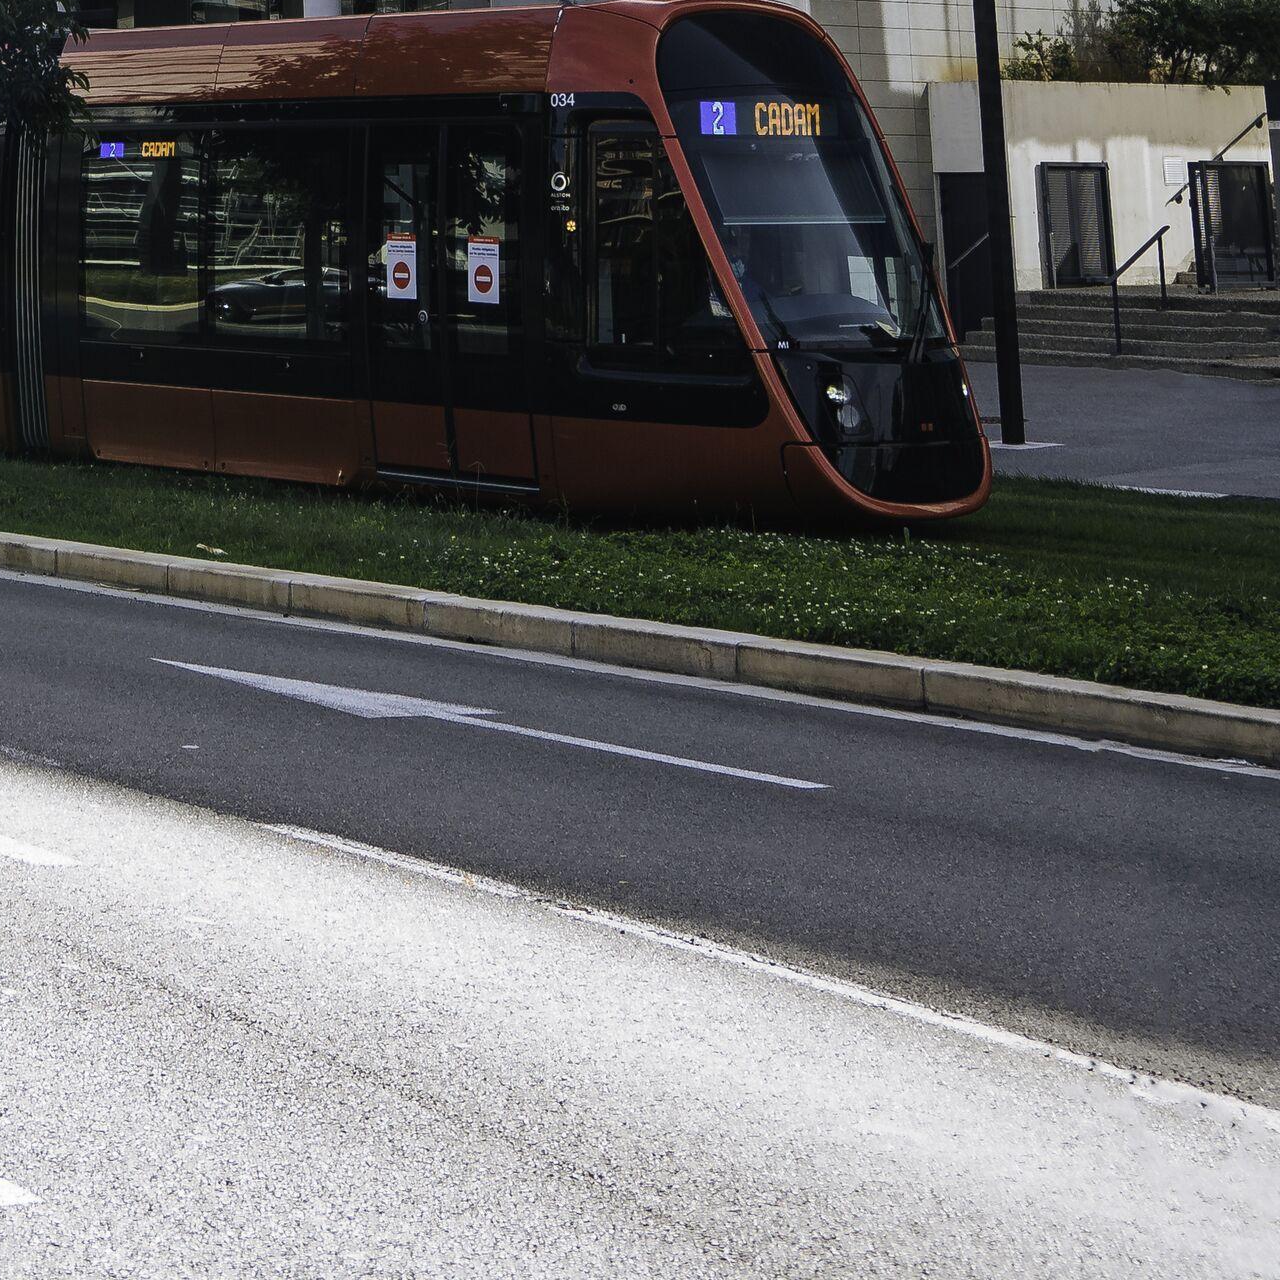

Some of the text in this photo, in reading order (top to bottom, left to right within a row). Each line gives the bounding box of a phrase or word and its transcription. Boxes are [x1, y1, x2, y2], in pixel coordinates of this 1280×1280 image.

[550, 93, 575, 107] 034
[711, 101, 821, 136] 2 CADAM
[109, 141, 176, 157] 2 CADAM
